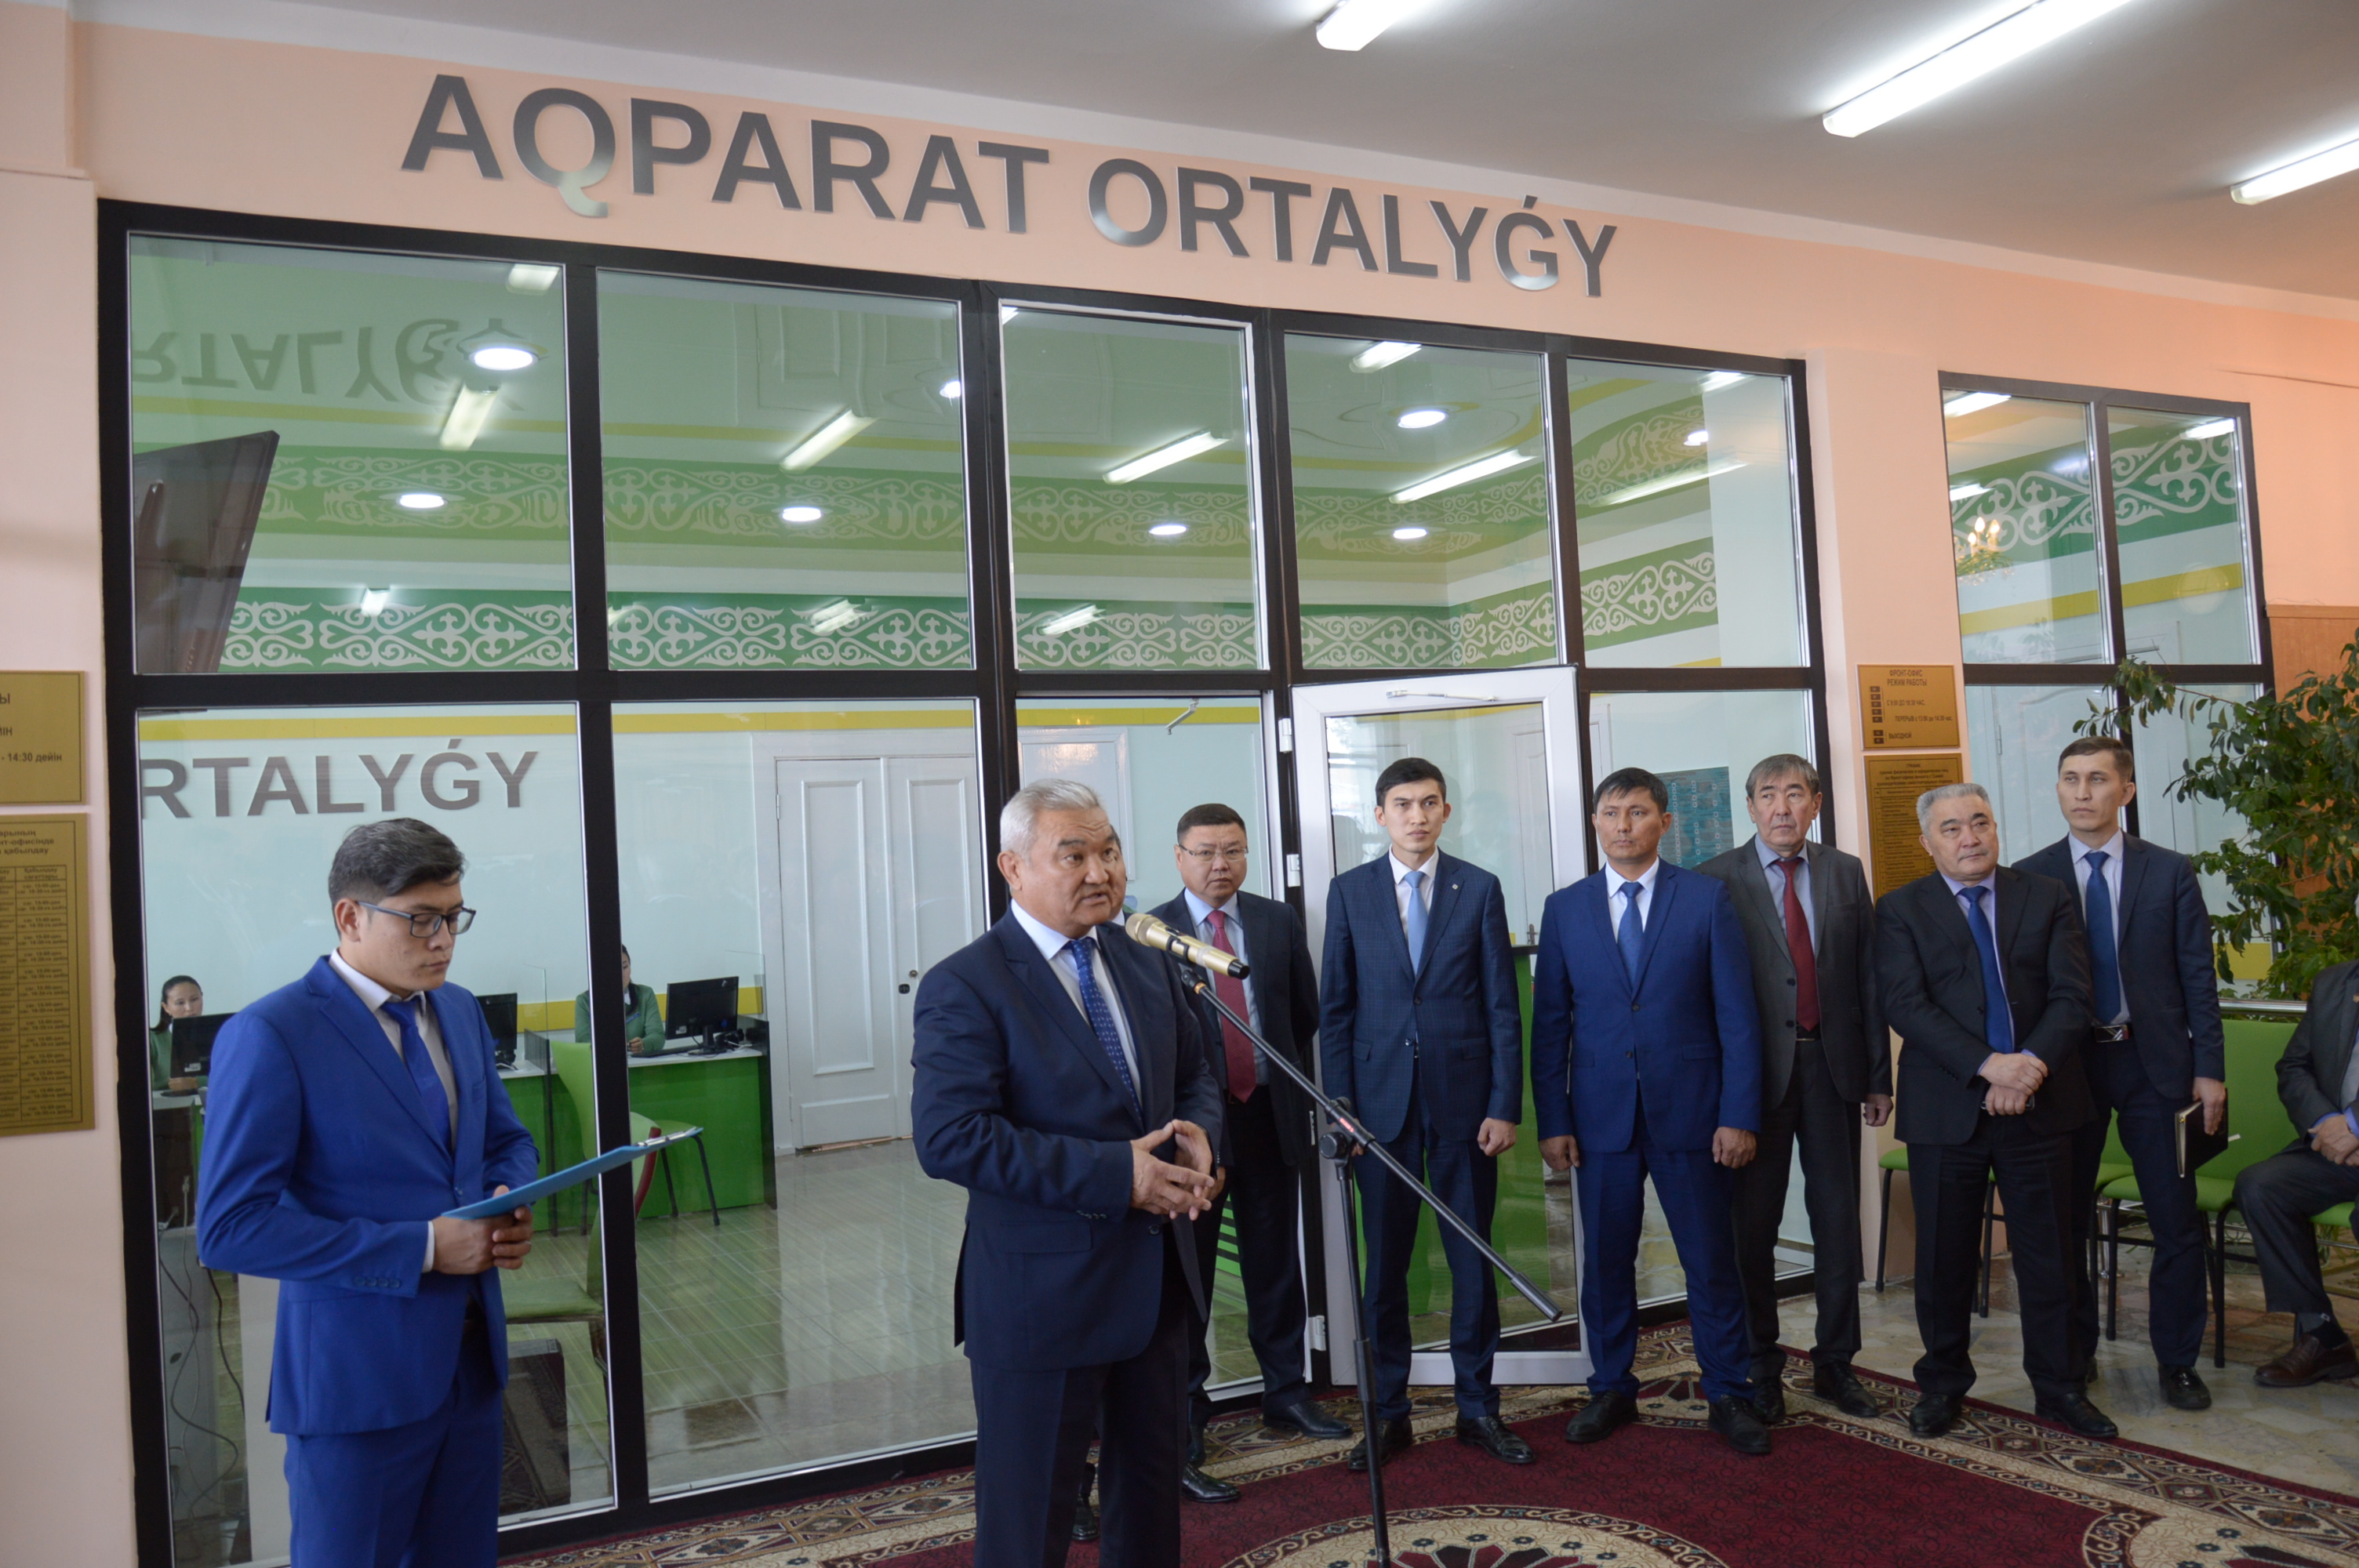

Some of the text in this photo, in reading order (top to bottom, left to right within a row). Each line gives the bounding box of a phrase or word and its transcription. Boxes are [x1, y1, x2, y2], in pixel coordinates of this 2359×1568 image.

[400, 73, 1618, 298] AQPARAT ORTALYǴY
[8, 753, 33, 763] 14:30
[35, 753, 62, 763] дейін
